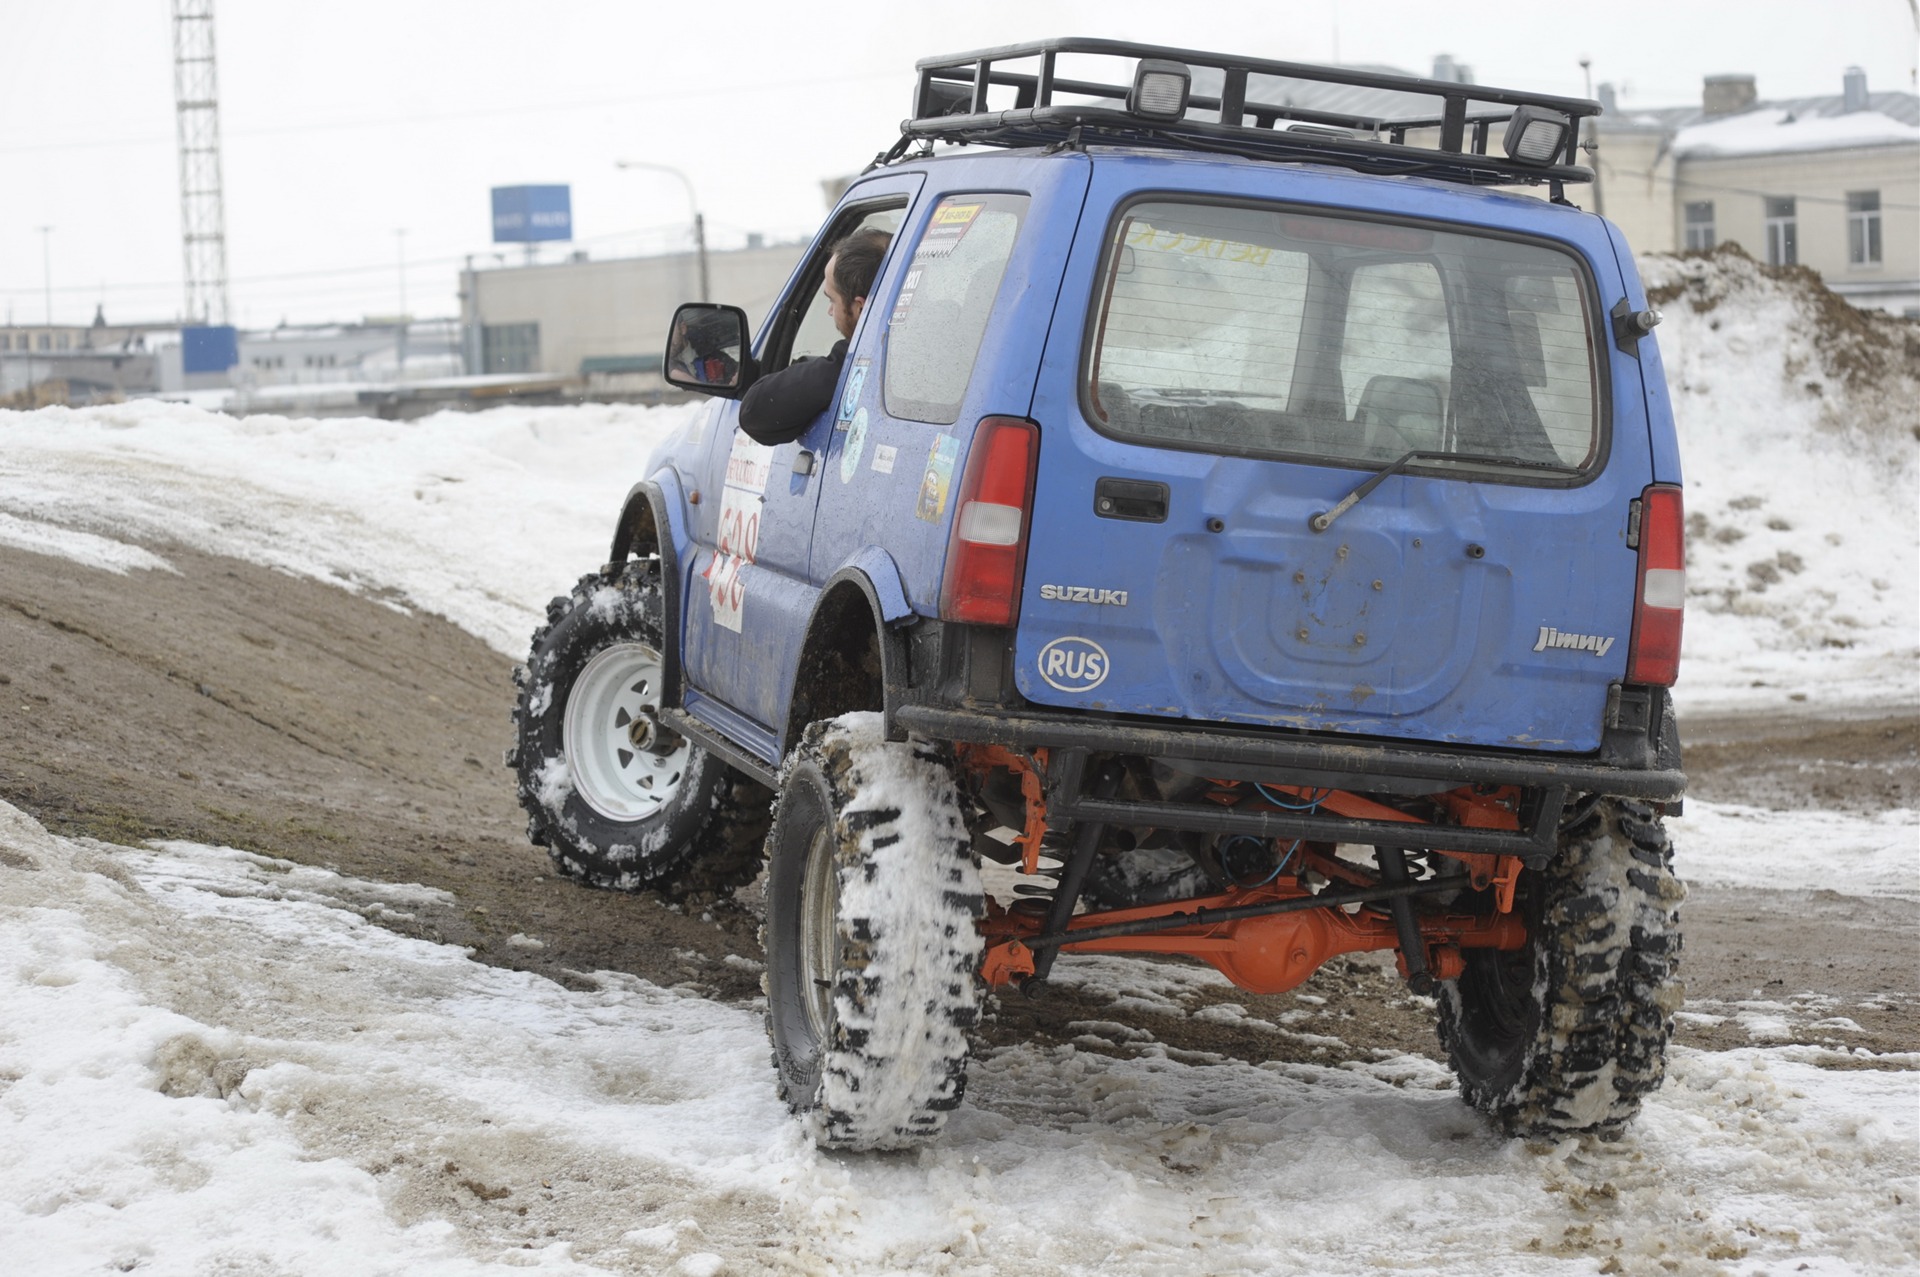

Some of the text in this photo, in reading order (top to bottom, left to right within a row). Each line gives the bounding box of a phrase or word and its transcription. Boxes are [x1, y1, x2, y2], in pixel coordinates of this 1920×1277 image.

[1040, 584, 1128, 606] SUZUKI
[1533, 626, 1615, 657] Jimny
[1047, 648, 1102, 681] RUS
